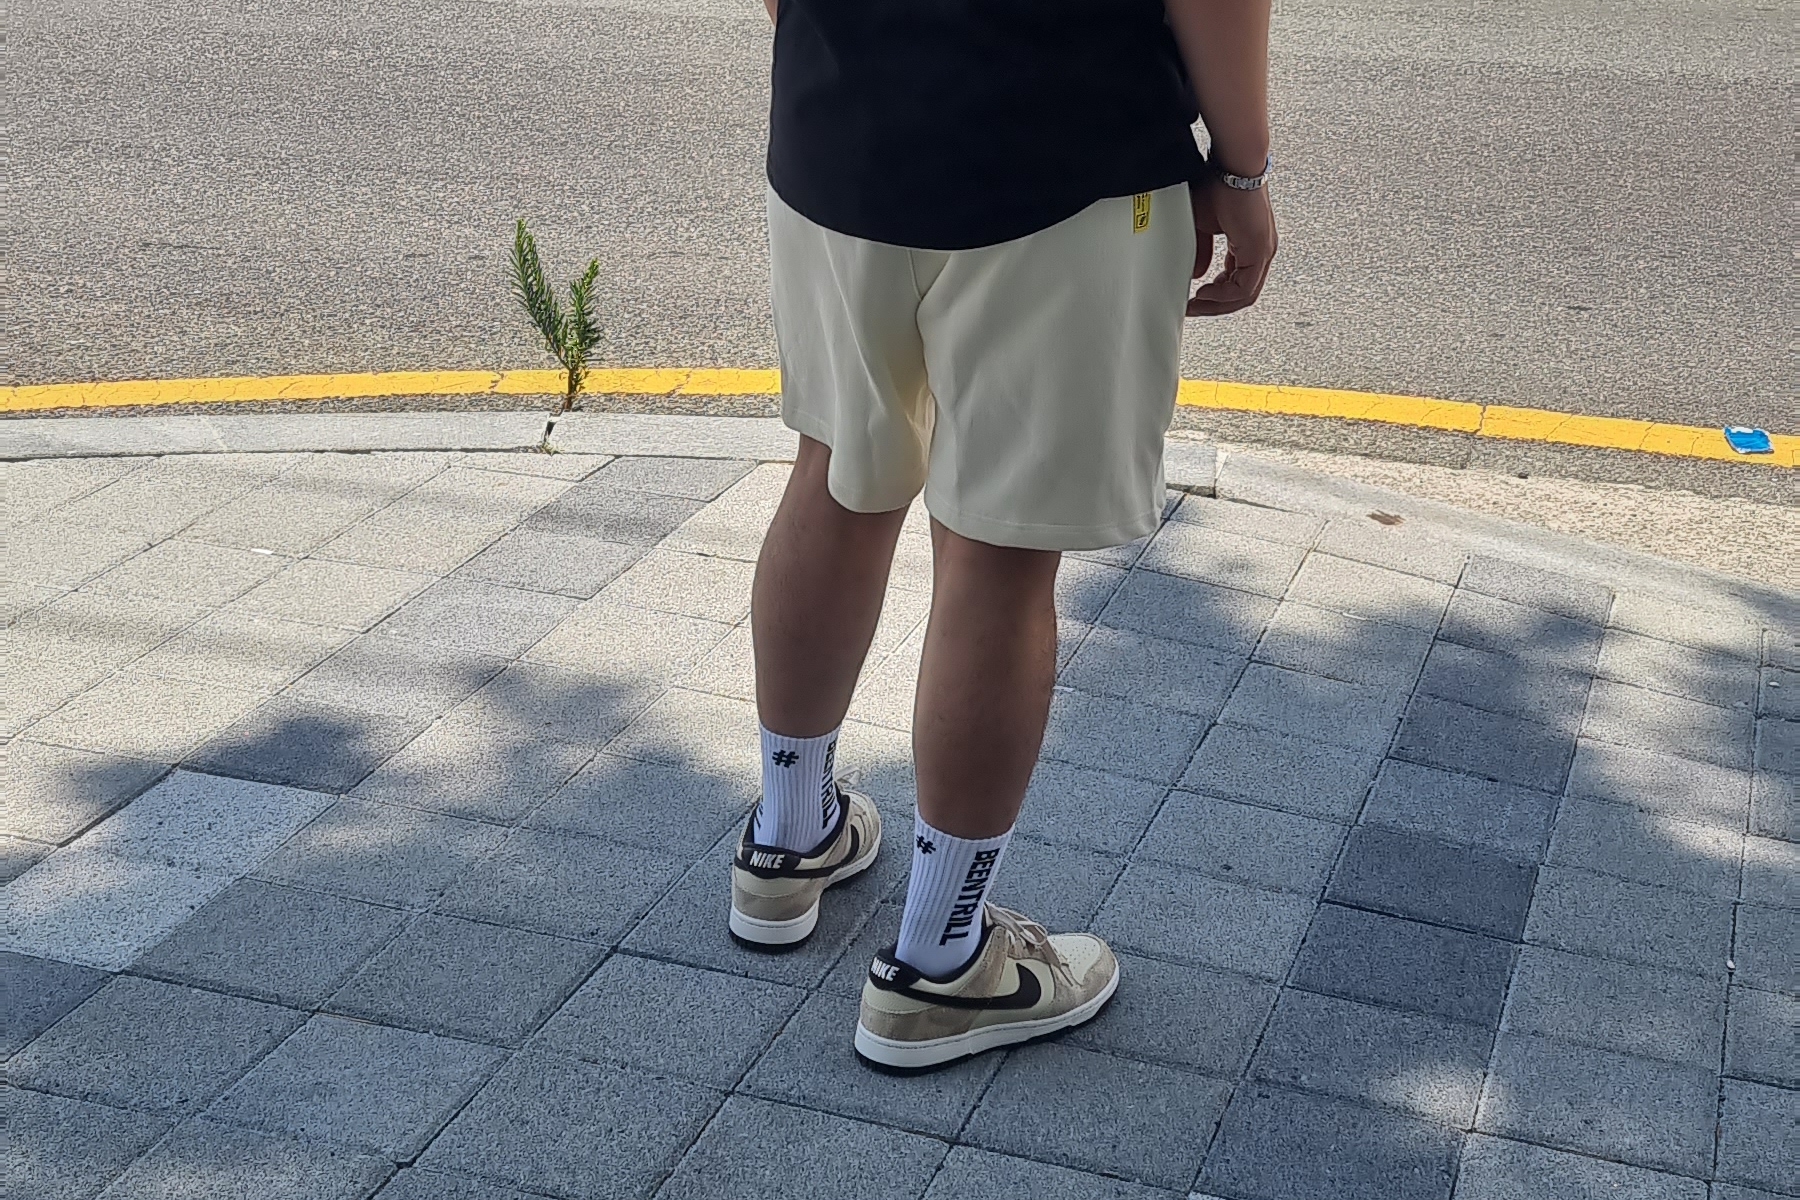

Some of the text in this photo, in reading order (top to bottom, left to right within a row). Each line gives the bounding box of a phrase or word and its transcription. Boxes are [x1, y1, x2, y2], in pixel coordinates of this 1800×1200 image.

[749, 850, 786, 870] NIKE
[938, 848, 1001, 947] BEENTRILL
[870, 956, 900, 982] NIKE
